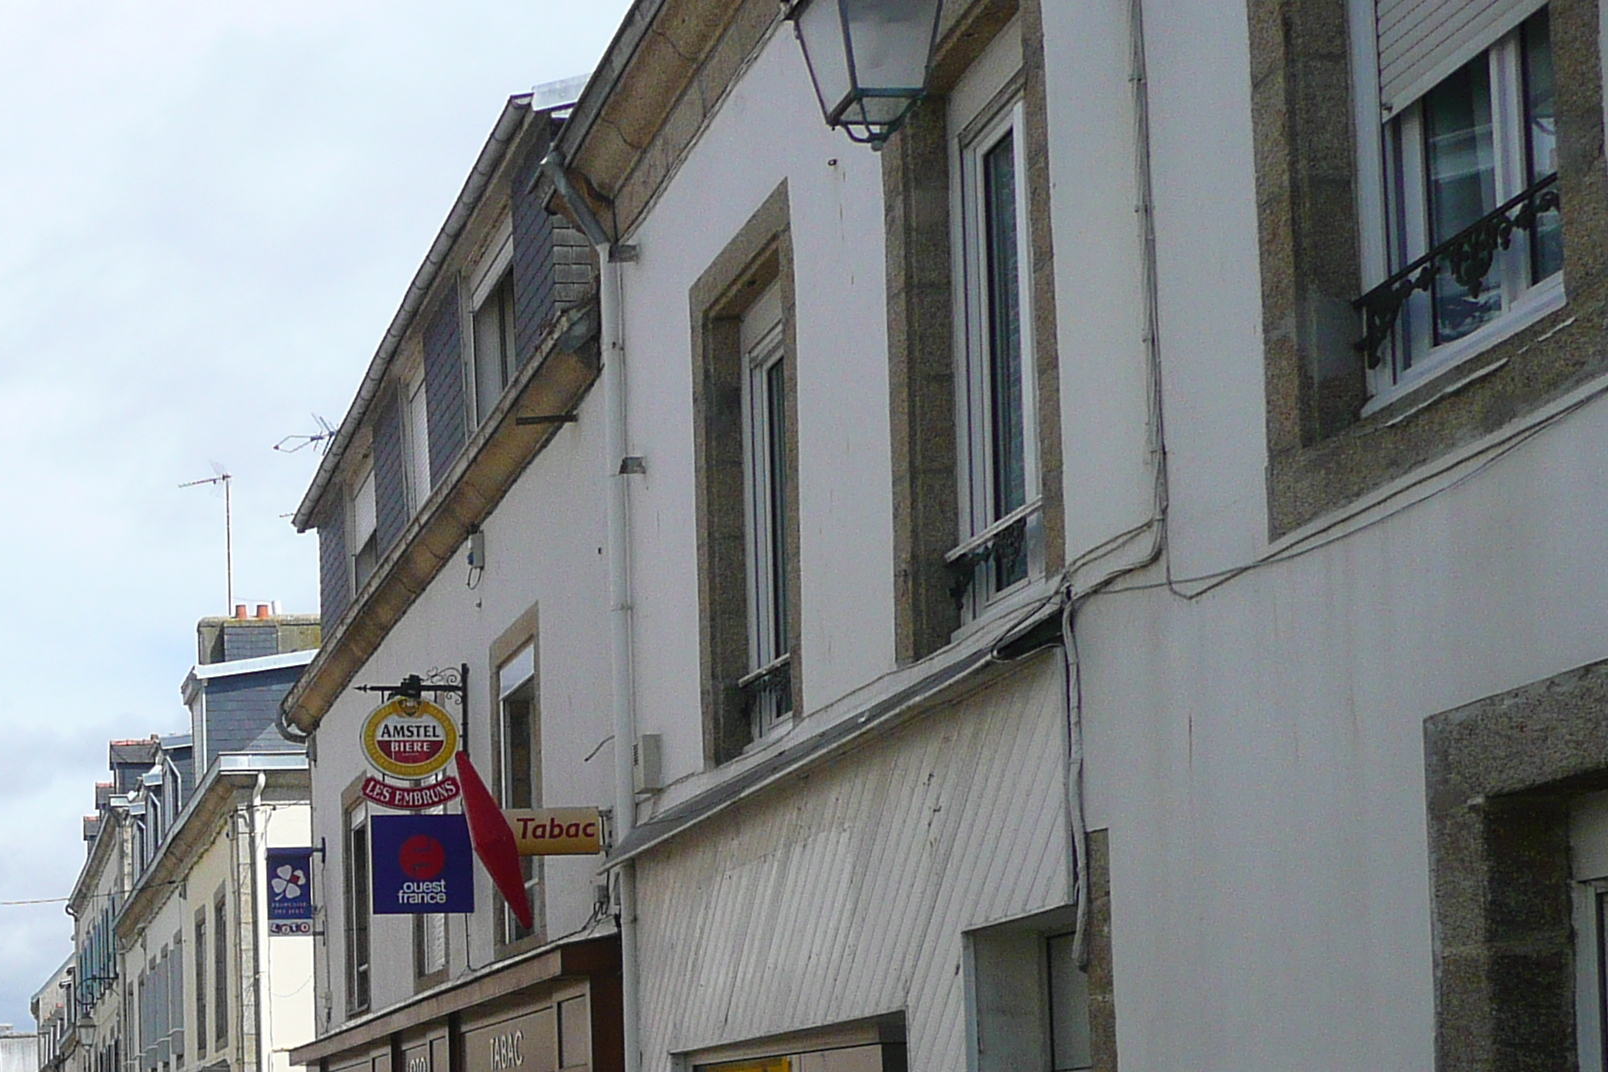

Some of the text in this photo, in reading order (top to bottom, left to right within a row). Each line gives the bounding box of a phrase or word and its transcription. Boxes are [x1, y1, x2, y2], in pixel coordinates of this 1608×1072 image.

[381, 724, 440, 738] AMSTEL
[365, 780, 456, 805] LES EMBRUNS
[516, 817, 596, 839] Tabac
[403, 878, 447, 893] ouest
[397, 890, 447, 904] france
[271, 922, 310, 934] LOTO
[489, 1030, 524, 1072] TABAC
